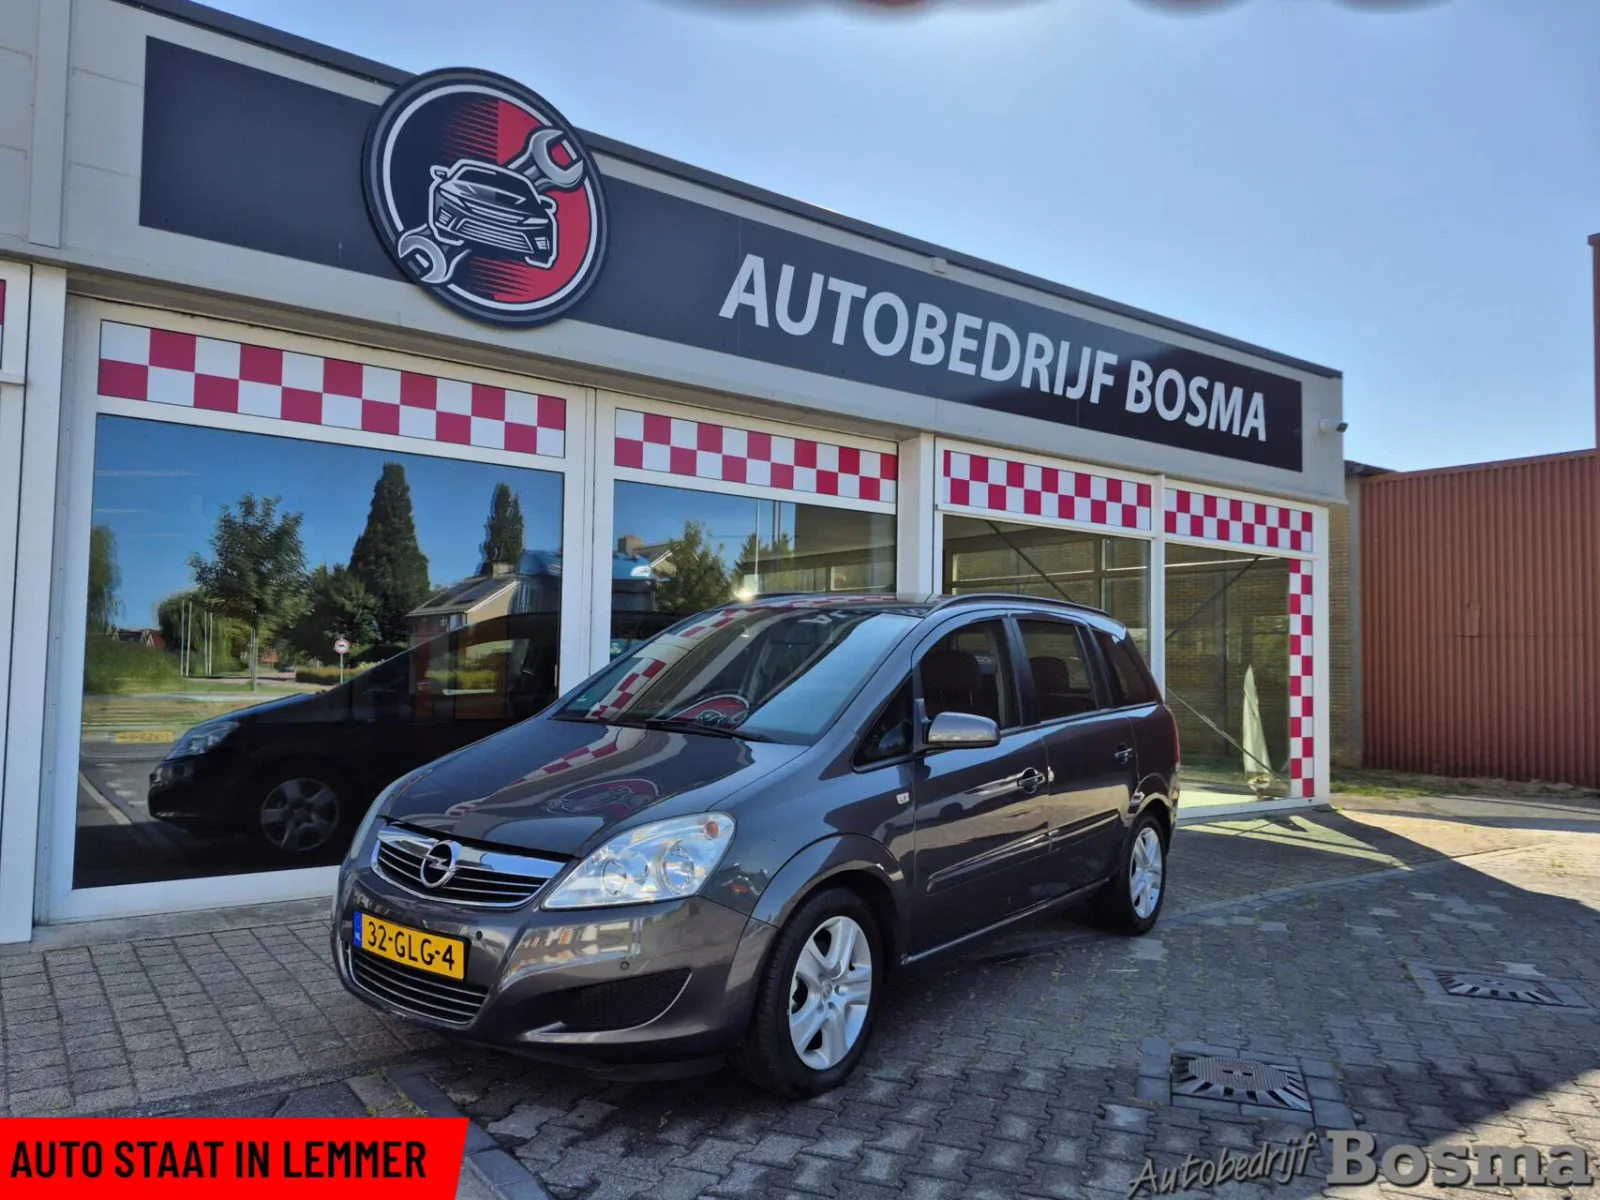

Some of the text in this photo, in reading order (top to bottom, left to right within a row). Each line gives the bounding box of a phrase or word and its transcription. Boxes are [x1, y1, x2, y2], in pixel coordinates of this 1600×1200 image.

[718, 253, 1267, 442] AUTOBEDRIJF BOSMA
[368, 920, 455, 971] 32-GLG-4
